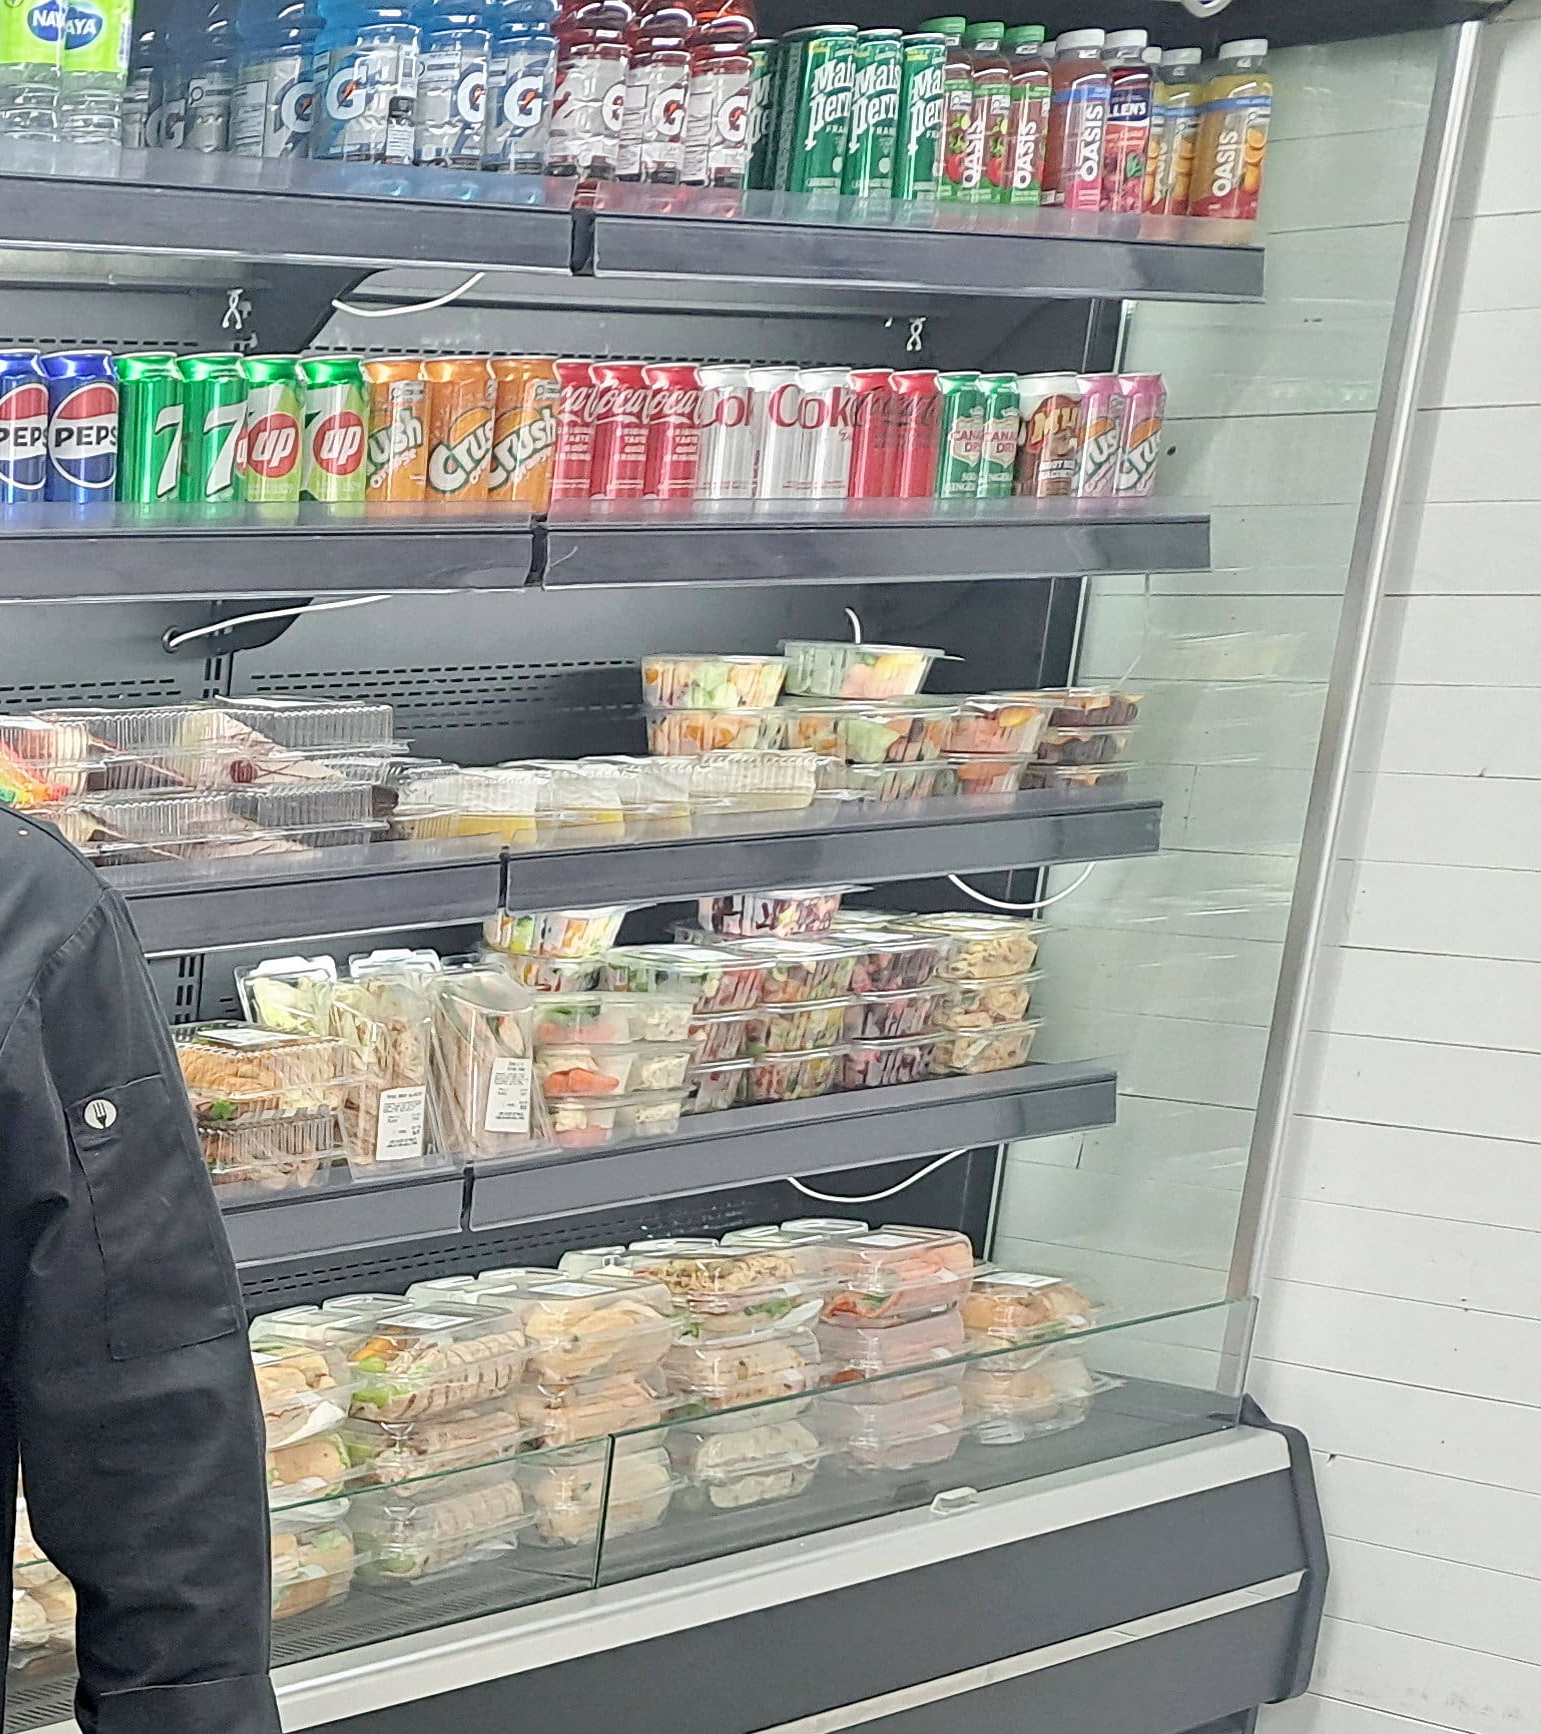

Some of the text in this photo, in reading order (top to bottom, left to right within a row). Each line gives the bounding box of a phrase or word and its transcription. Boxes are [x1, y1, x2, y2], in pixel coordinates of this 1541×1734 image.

[326, 66, 367, 120] G
[504, 75, 545, 127] G
[653, 94, 685, 136] G
[718, 95, 748, 141] G
[1079, 103, 1104, 182] OASIS
[1212, 129, 1238, 197] OASIS
[55, 425, 117, 448] PEPS
